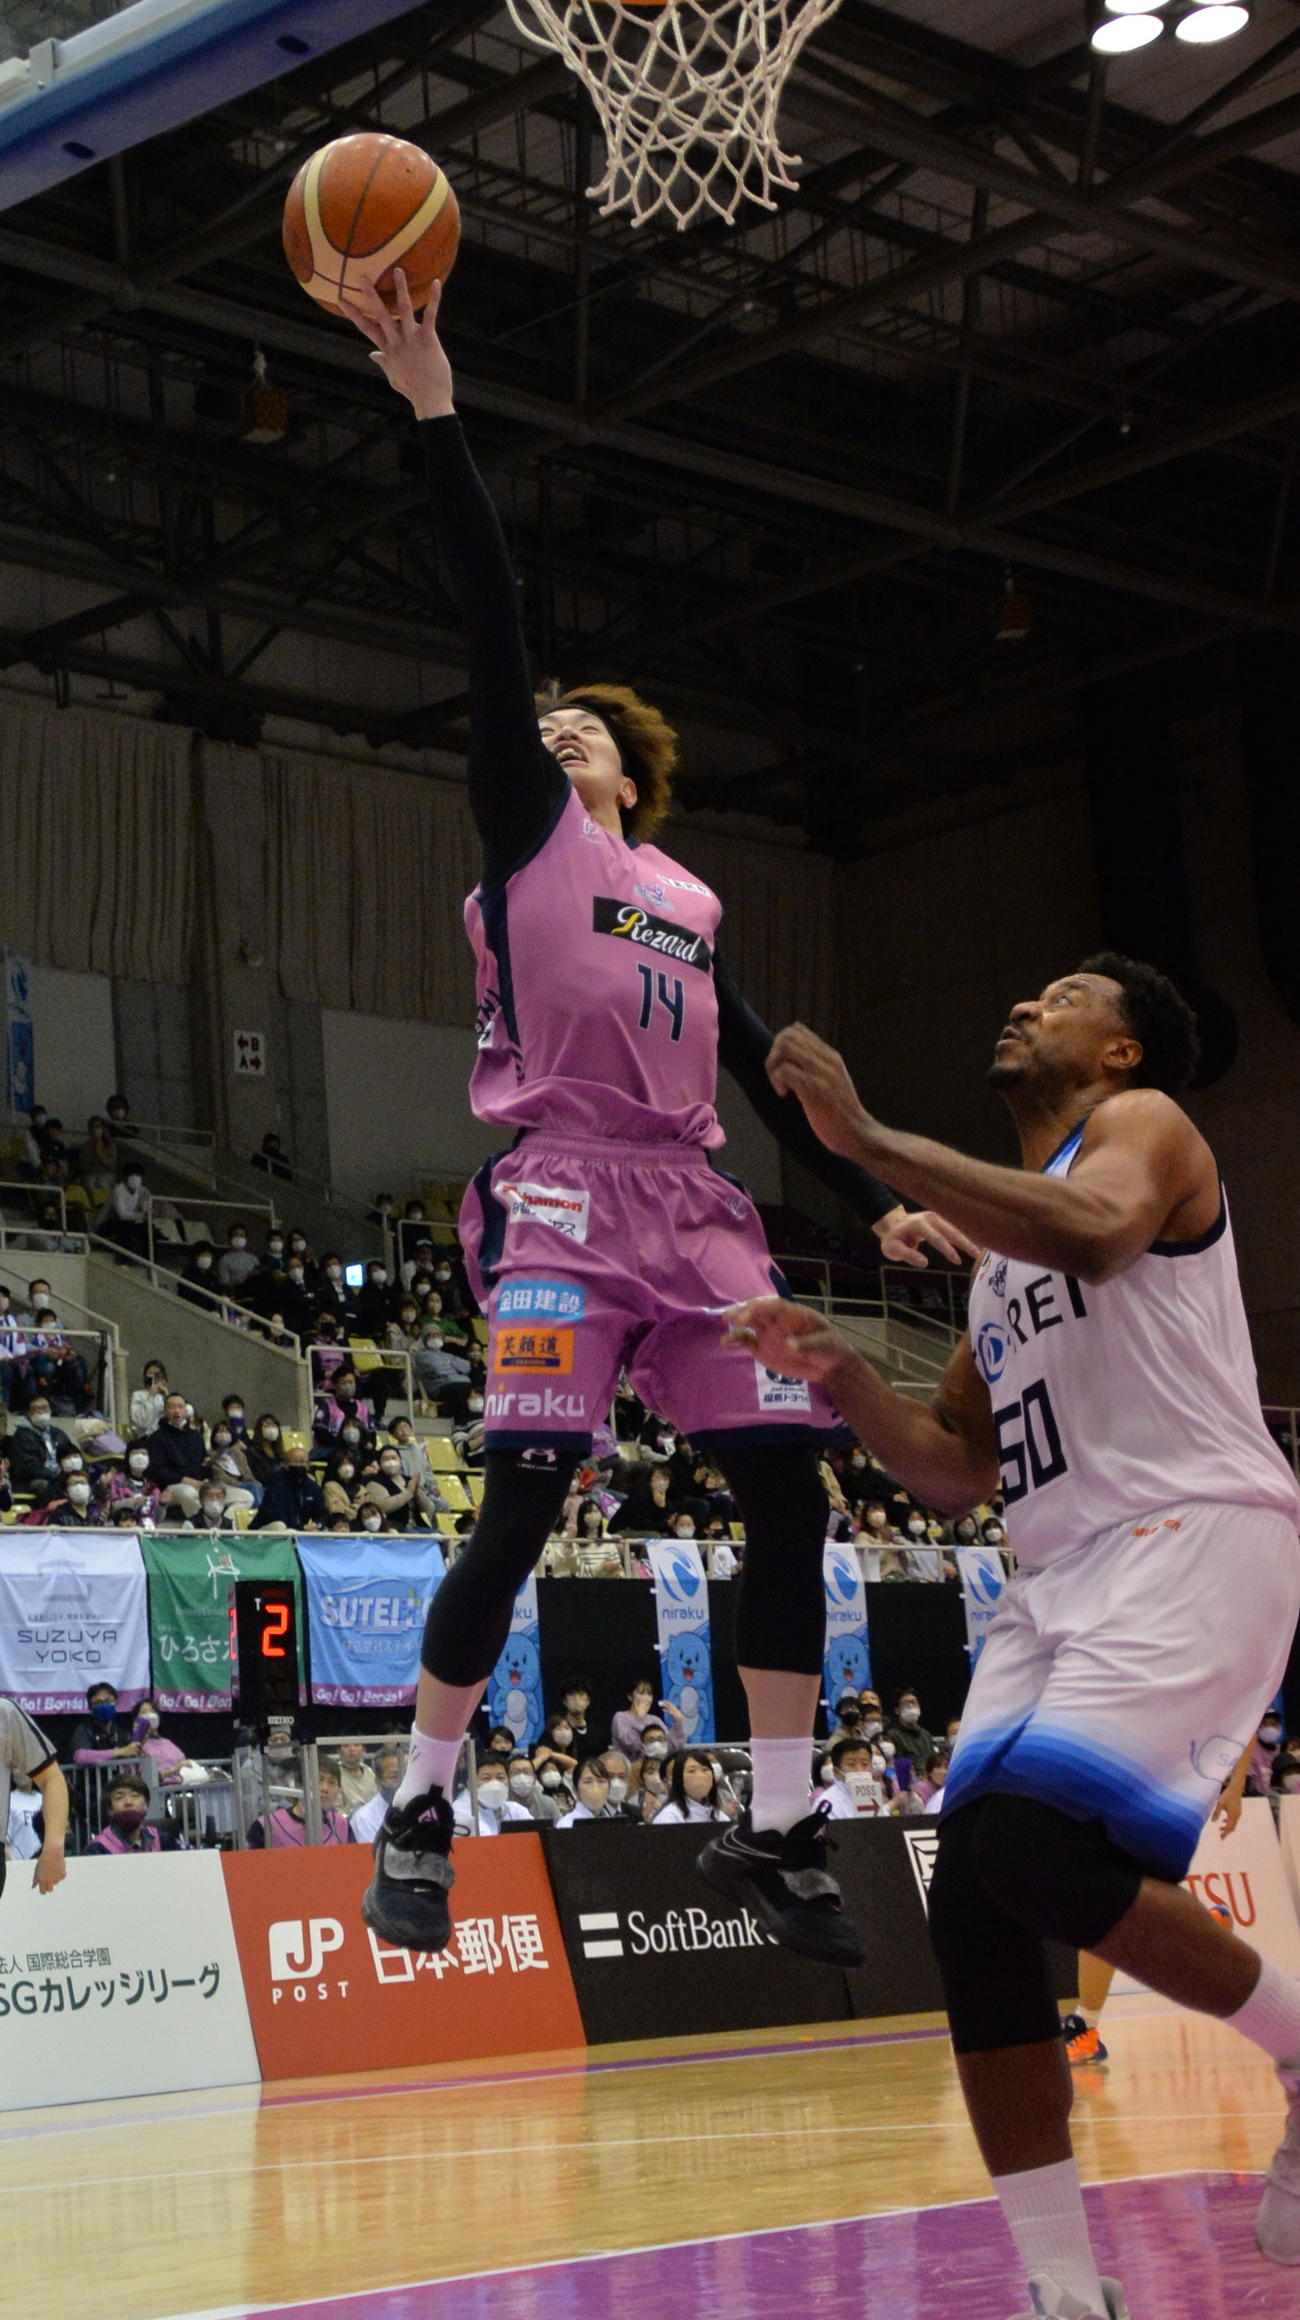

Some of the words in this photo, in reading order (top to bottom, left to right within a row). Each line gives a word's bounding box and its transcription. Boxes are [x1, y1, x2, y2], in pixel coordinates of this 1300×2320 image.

[611, 905, 702, 962] Rezard
[636, 961, 684, 1044] 14
[239, 1054, 249, 1070] A
[485, 1383, 585, 1417] niraku
[993, 1378, 1068, 1506] 50
[662, 1604, 705, 1620] niraku
[17, 1630, 117, 1643] SUZUYA
[262, 1605, 289, 1656] 2
[36, 1650, 101, 1663] YOKO
[158, 1634, 230, 1663] ひろさ
[627, 1907, 764, 1955] SoftBank
[272, 1980, 349, 2005] POST
